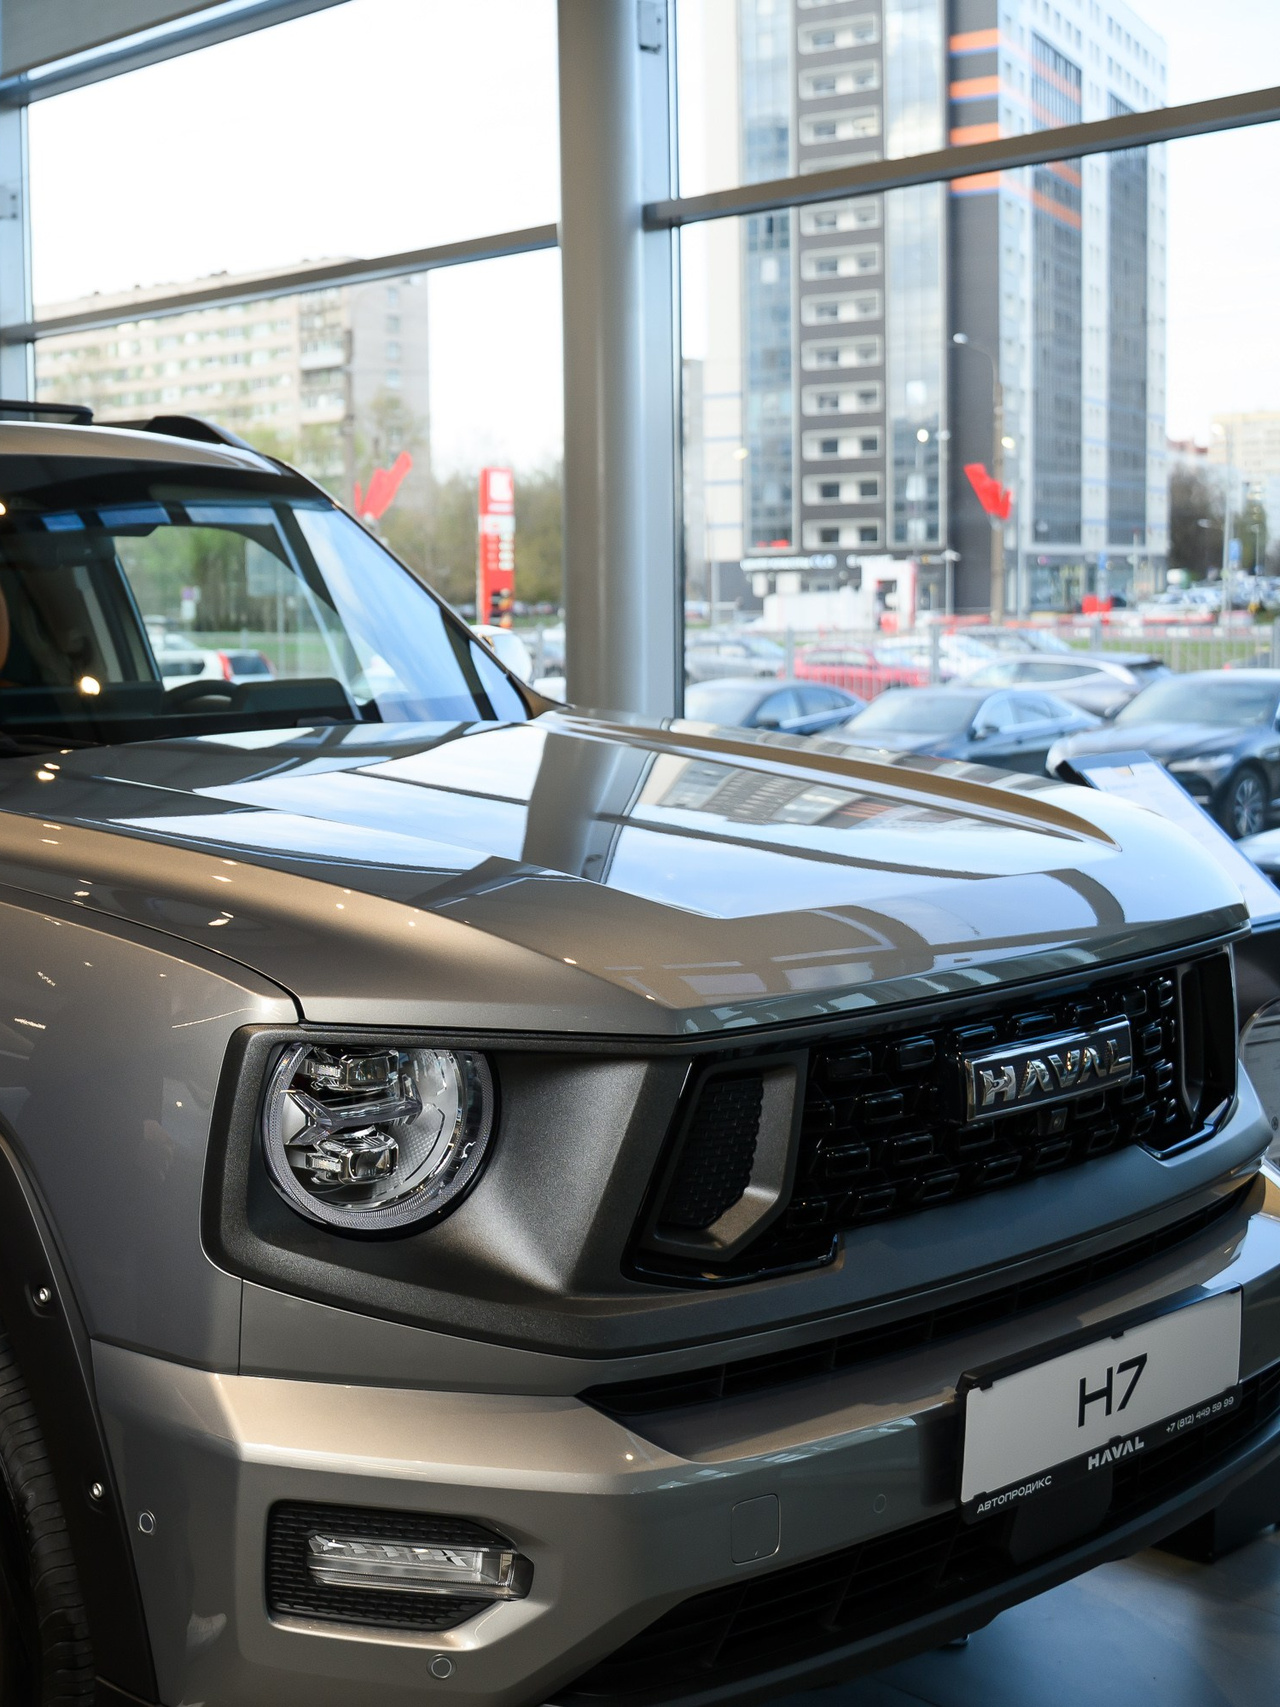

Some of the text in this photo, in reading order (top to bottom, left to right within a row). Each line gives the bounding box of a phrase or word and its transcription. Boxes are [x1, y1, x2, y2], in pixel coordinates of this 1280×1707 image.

[979, 1038, 1132, 1107] HAVAL
[1077, 1352, 1148, 1428] H7
[1165, 1422, 1176, 1433] +7
[1176, 1413, 1195, 1430] (812)
[1195, 1406, 1211, 1419] 449
[1223, 1396, 1234, 1408] 99
[1087, 1436, 1145, 1471] HAVAL
[976, 1475, 1053, 1514] АВТОПРОДИКС
